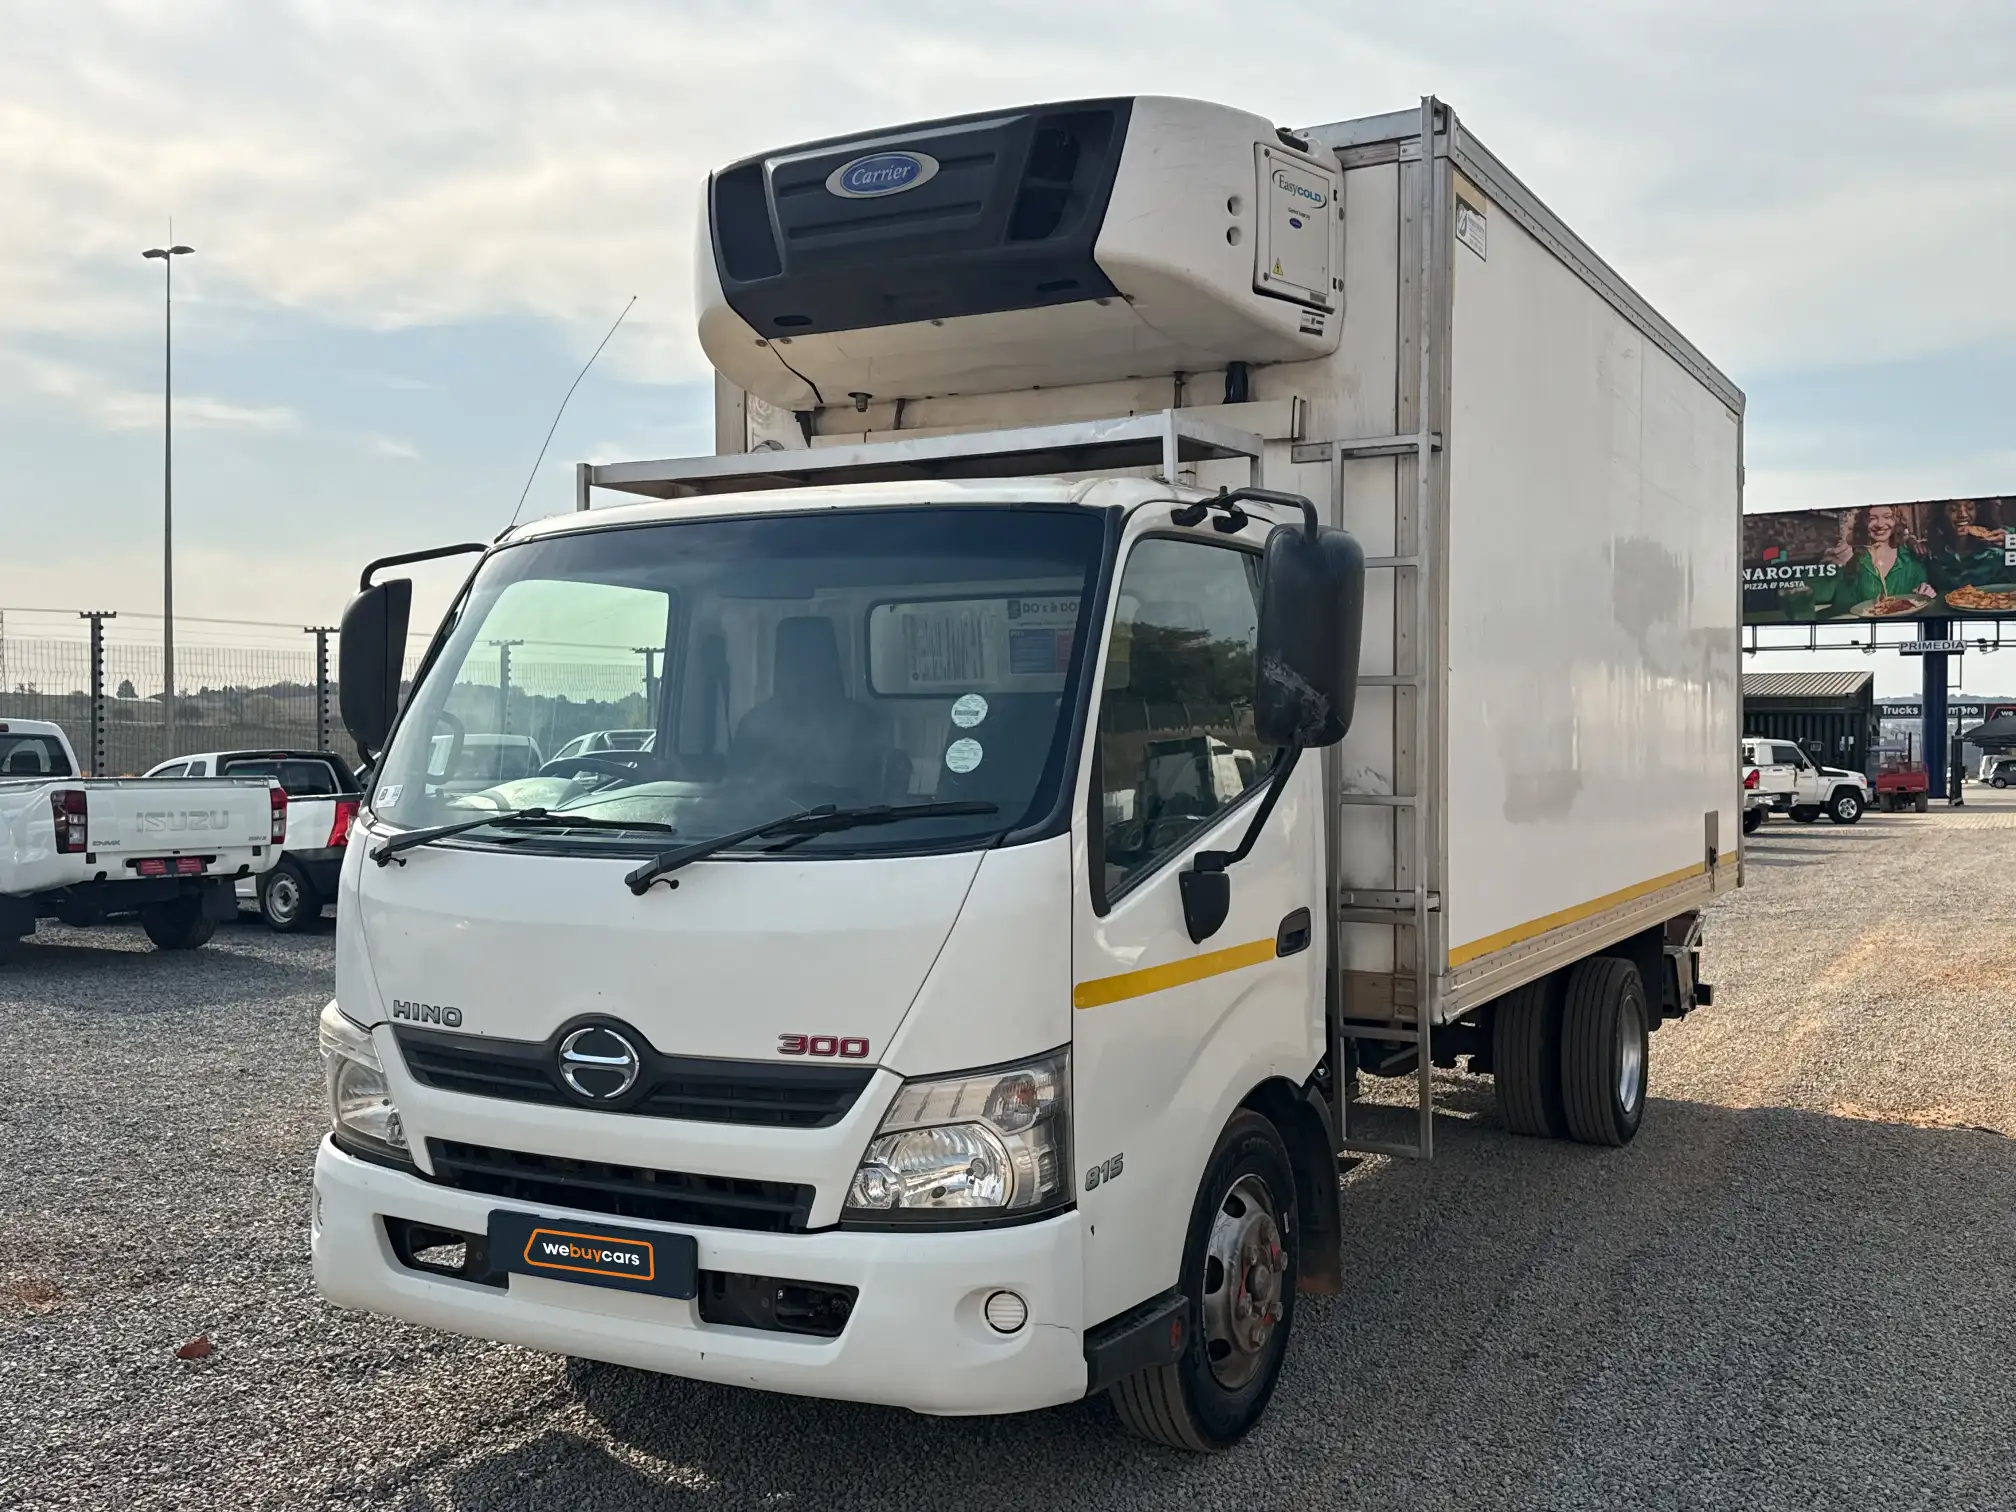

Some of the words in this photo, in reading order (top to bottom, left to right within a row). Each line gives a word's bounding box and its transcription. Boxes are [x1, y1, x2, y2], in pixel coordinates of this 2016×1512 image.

[851, 164, 912, 186] Carrier
[1278, 174, 1322, 203] EasyCOLD
[1744, 582, 1768, 590] PIZZA
[1779, 580, 1805, 589] PASTA
[1900, 641, 1964, 651] PRIMEDIA
[1882, 705, 1918, 715] Trucks
[136, 810, 229, 833] ISUZU
[393, 999, 462, 1028] HINO
[776, 1032, 870, 1059] 300
[1085, 1152, 1124, 1192] 815
[542, 1242, 641, 1266] webuycars
